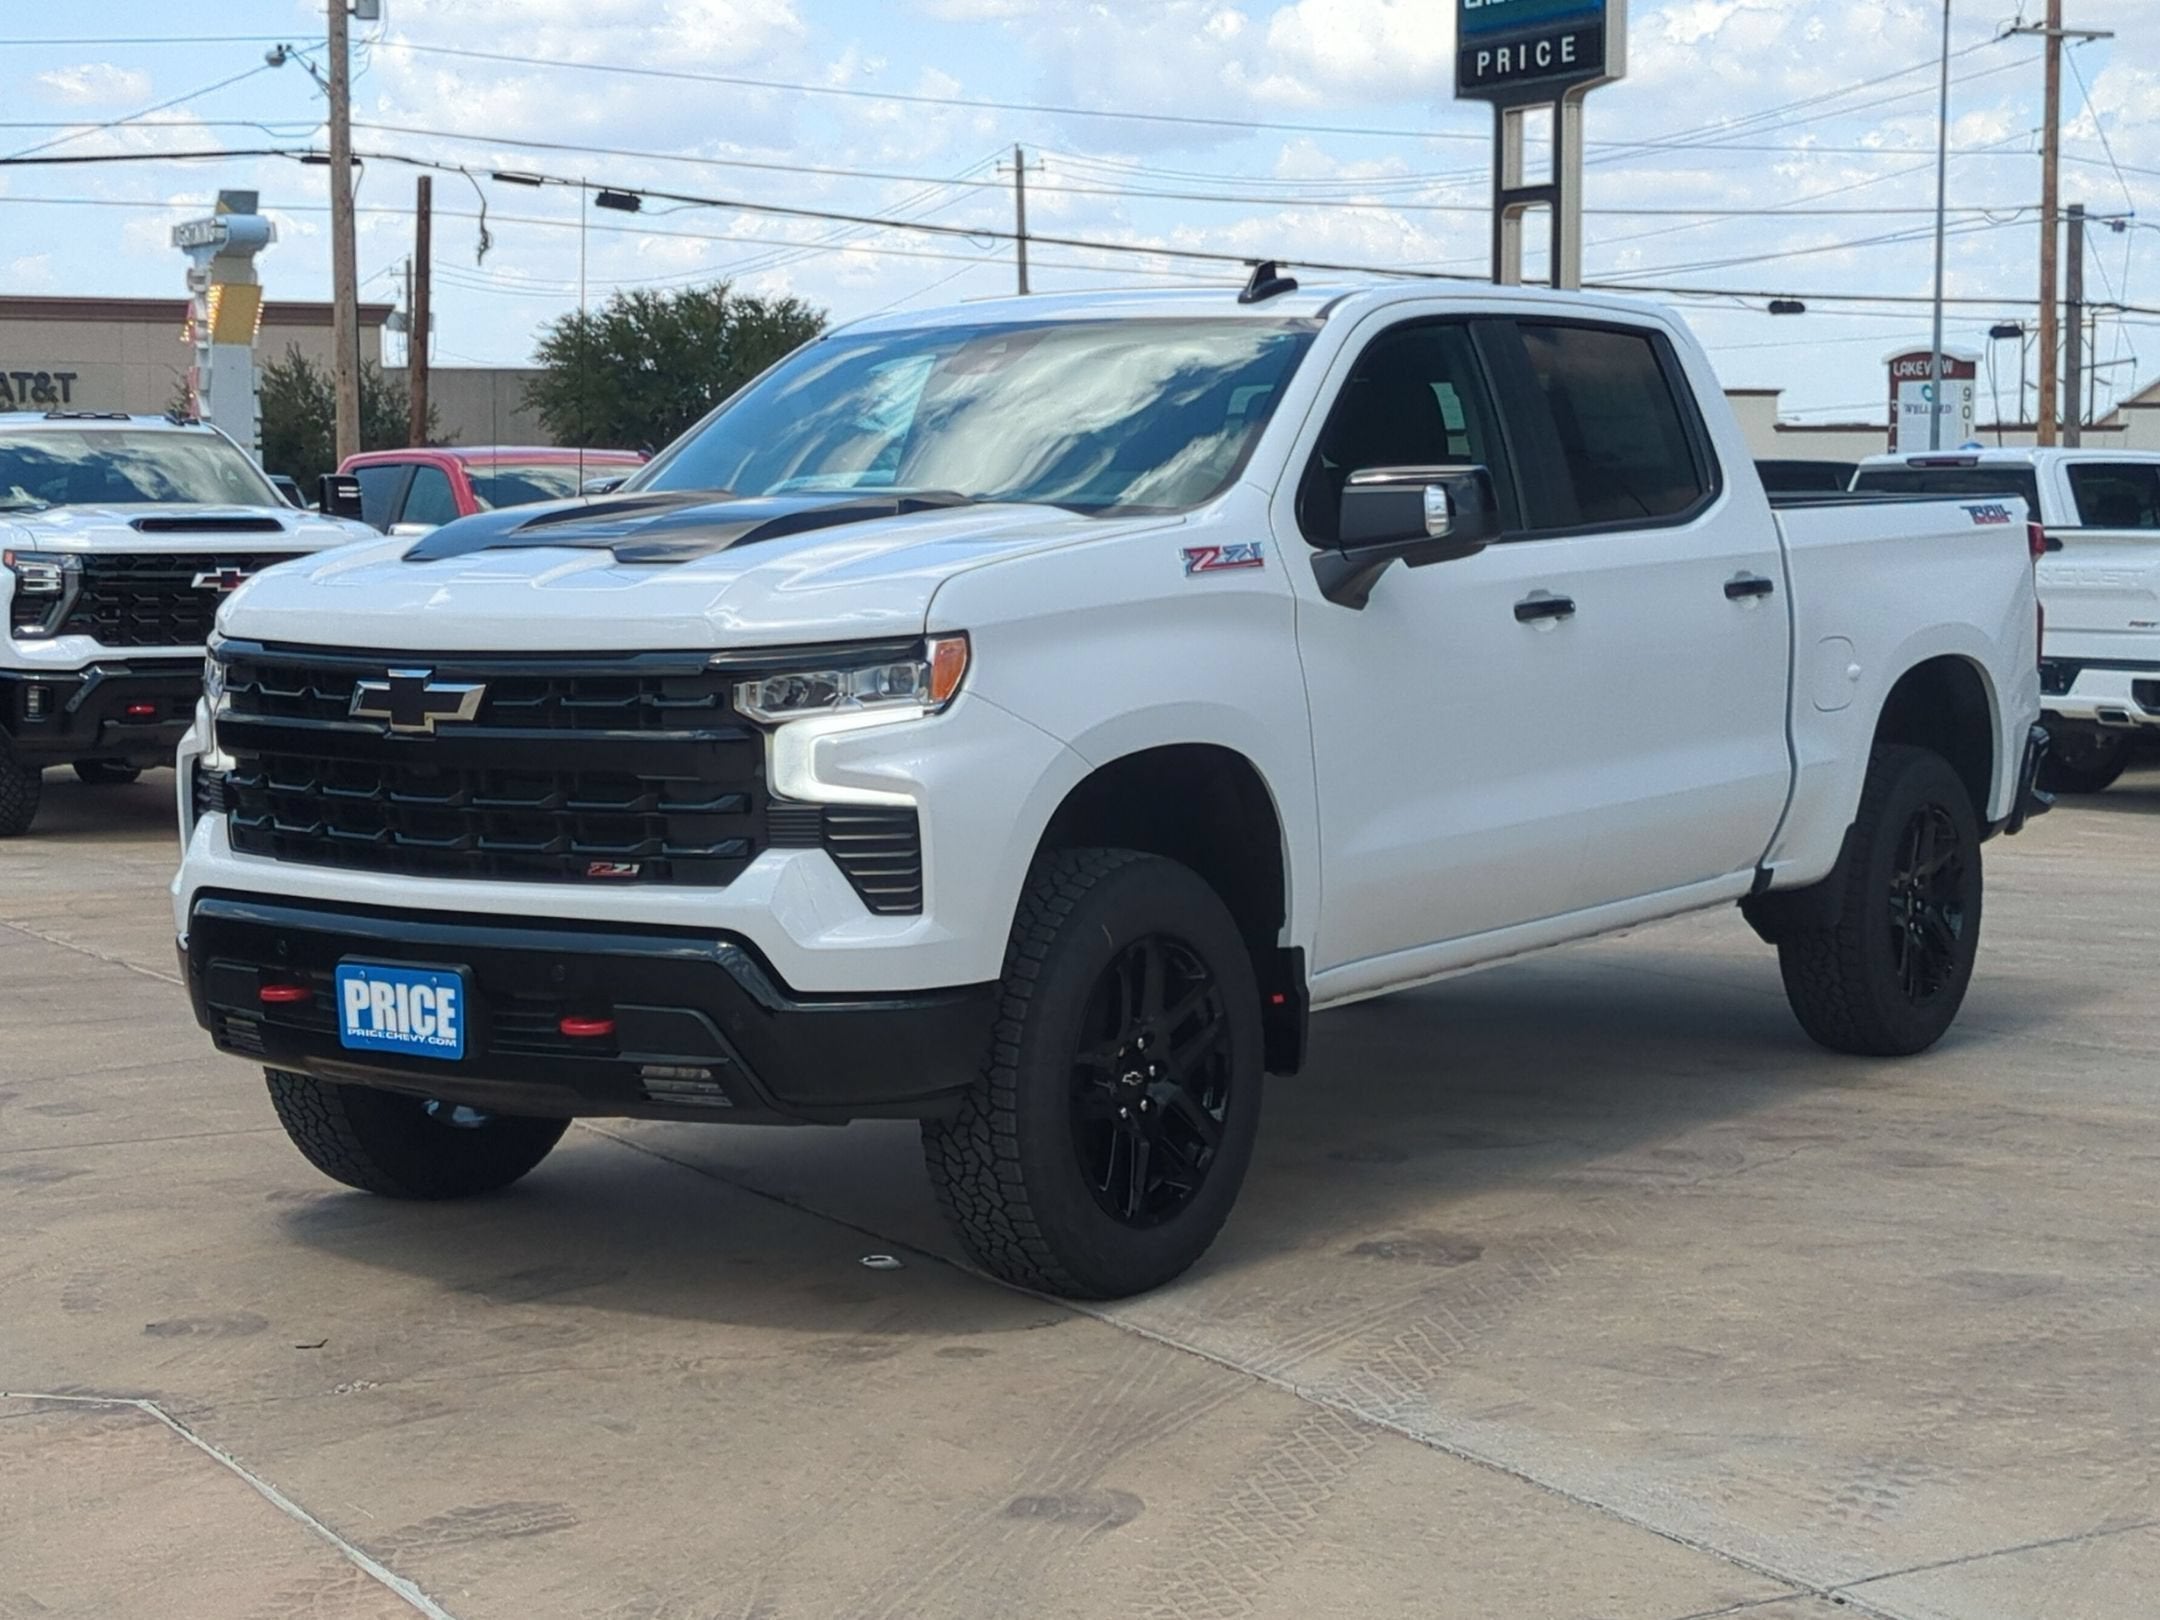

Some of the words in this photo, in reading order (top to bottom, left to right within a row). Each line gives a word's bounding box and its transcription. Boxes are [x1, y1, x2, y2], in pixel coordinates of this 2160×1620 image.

[1476, 36, 1575, 77] PRICE
[1893, 359, 1954, 376] LAKEVW
[0, 371, 77, 404] AT&T
[1904, 403, 1952, 415] WELLD
[1180, 540, 1264, 574] Z71
[587, 862, 641, 876] Z71
[343, 978, 457, 1039] PRICE
[347, 1028, 457, 1047] PRICECHEVY.COM
